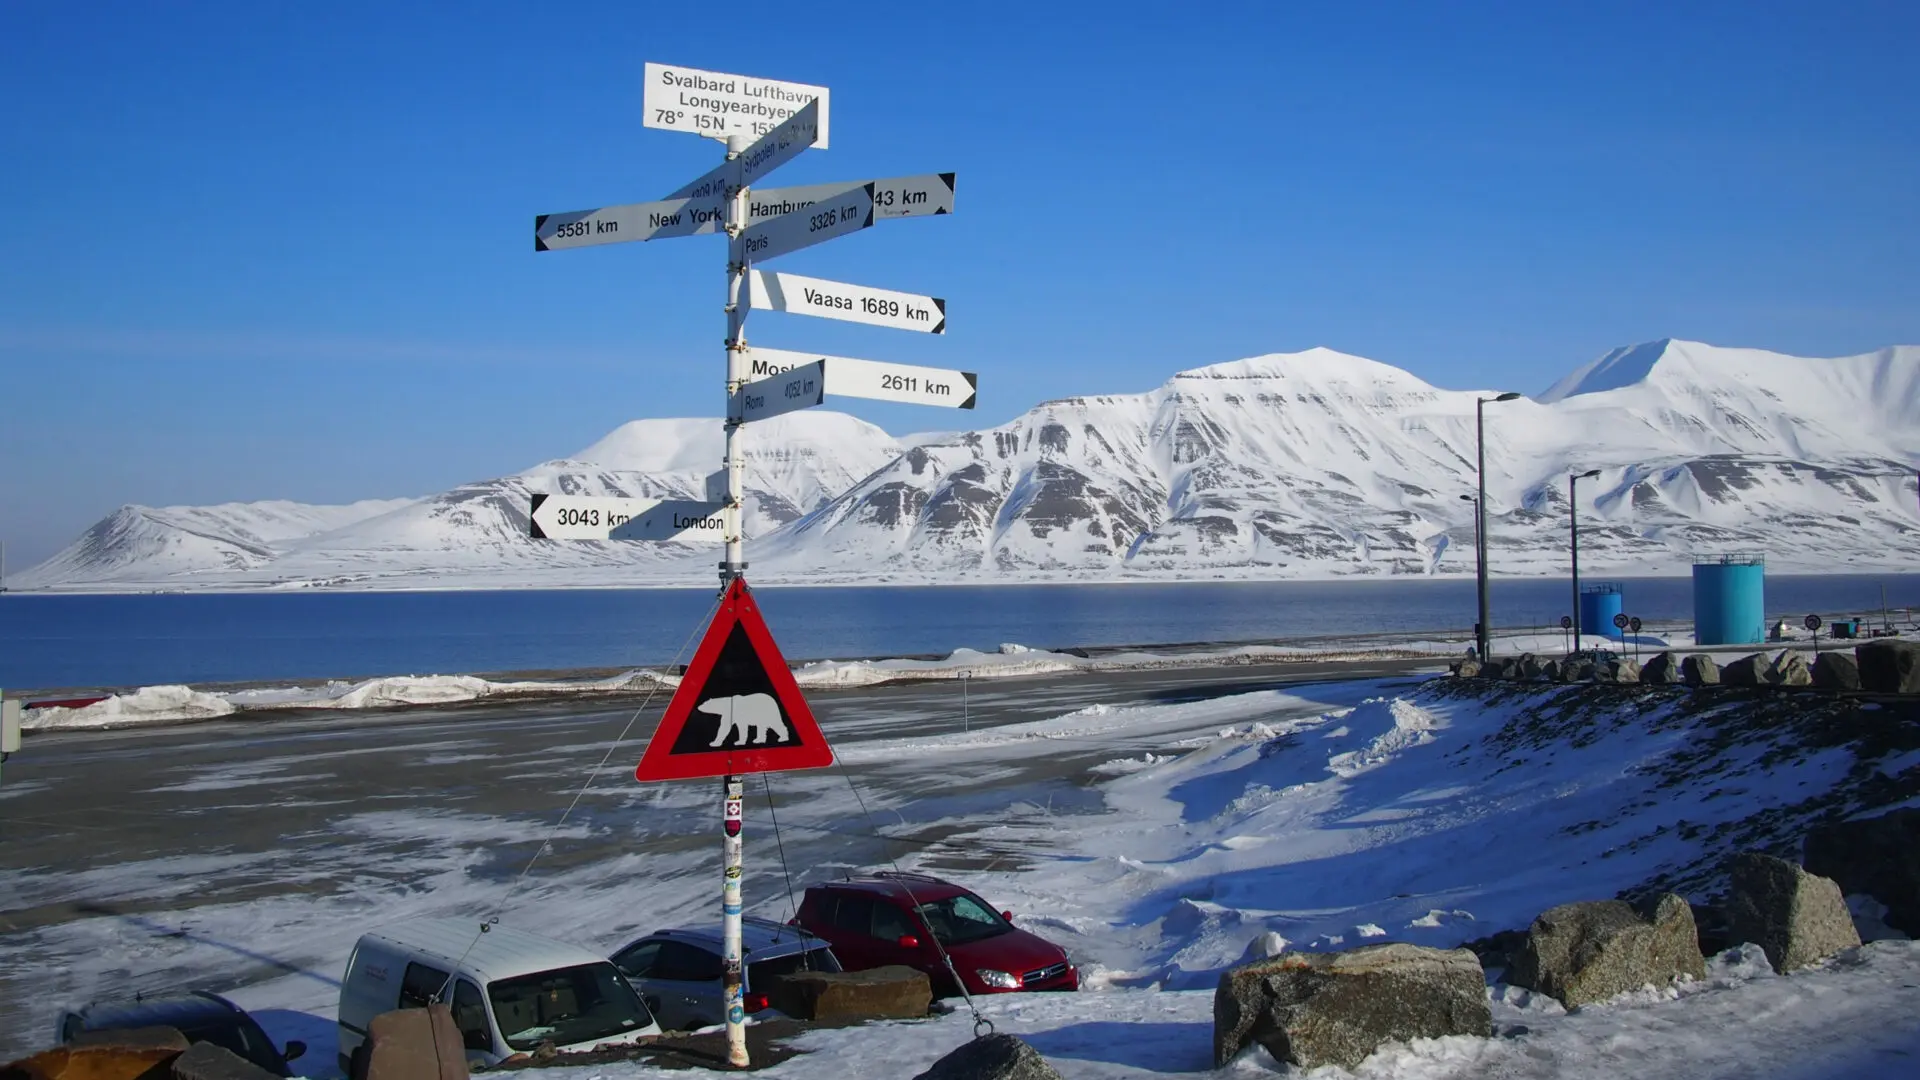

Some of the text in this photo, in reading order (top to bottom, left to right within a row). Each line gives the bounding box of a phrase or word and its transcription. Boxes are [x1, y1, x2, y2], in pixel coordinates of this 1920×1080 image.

[662, 71, 813, 104] Svalbard Lufthavn
[655, 109, 685, 125] 78°
[679, 92, 796, 119] Longyearbyen
[874, 190, 895, 206] 43
[902, 189, 928, 206] km
[557, 207, 723, 239] 5581 km New York
[746, 206, 858, 254] Paris 3326 km
[804, 287, 930, 322] Vaasa 1689 km
[803, 378, 815, 396] km
[881, 375, 918, 393] 2611
[925, 379, 951, 396] km
[557, 508, 725, 530] 3043 km London
